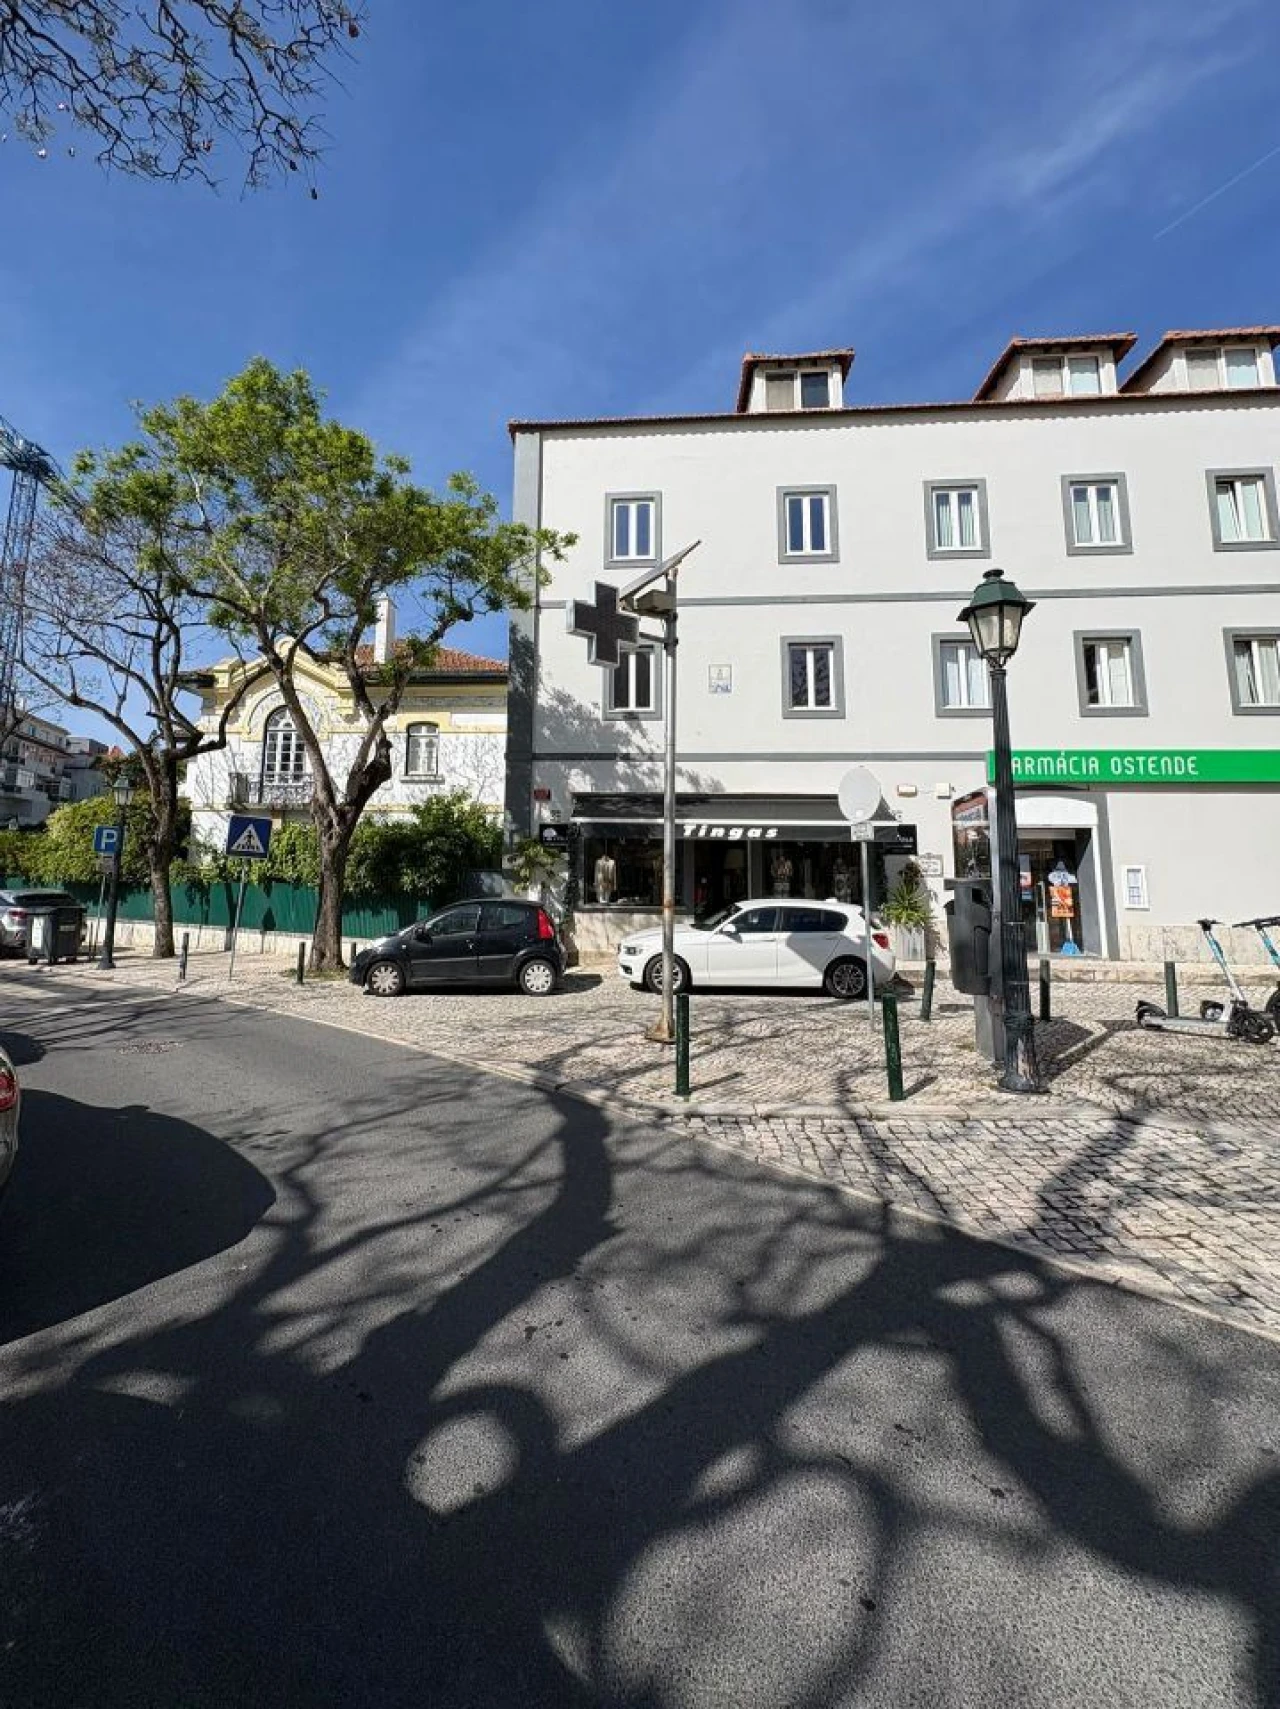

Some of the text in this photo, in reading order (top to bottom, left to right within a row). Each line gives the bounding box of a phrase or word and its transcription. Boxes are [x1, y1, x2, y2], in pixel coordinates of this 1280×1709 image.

[1011, 752, 1199, 775] ARMÁCIA OSTENDE
[101, 829, 117, 850] P
[683, 824, 779, 840] Tingas
